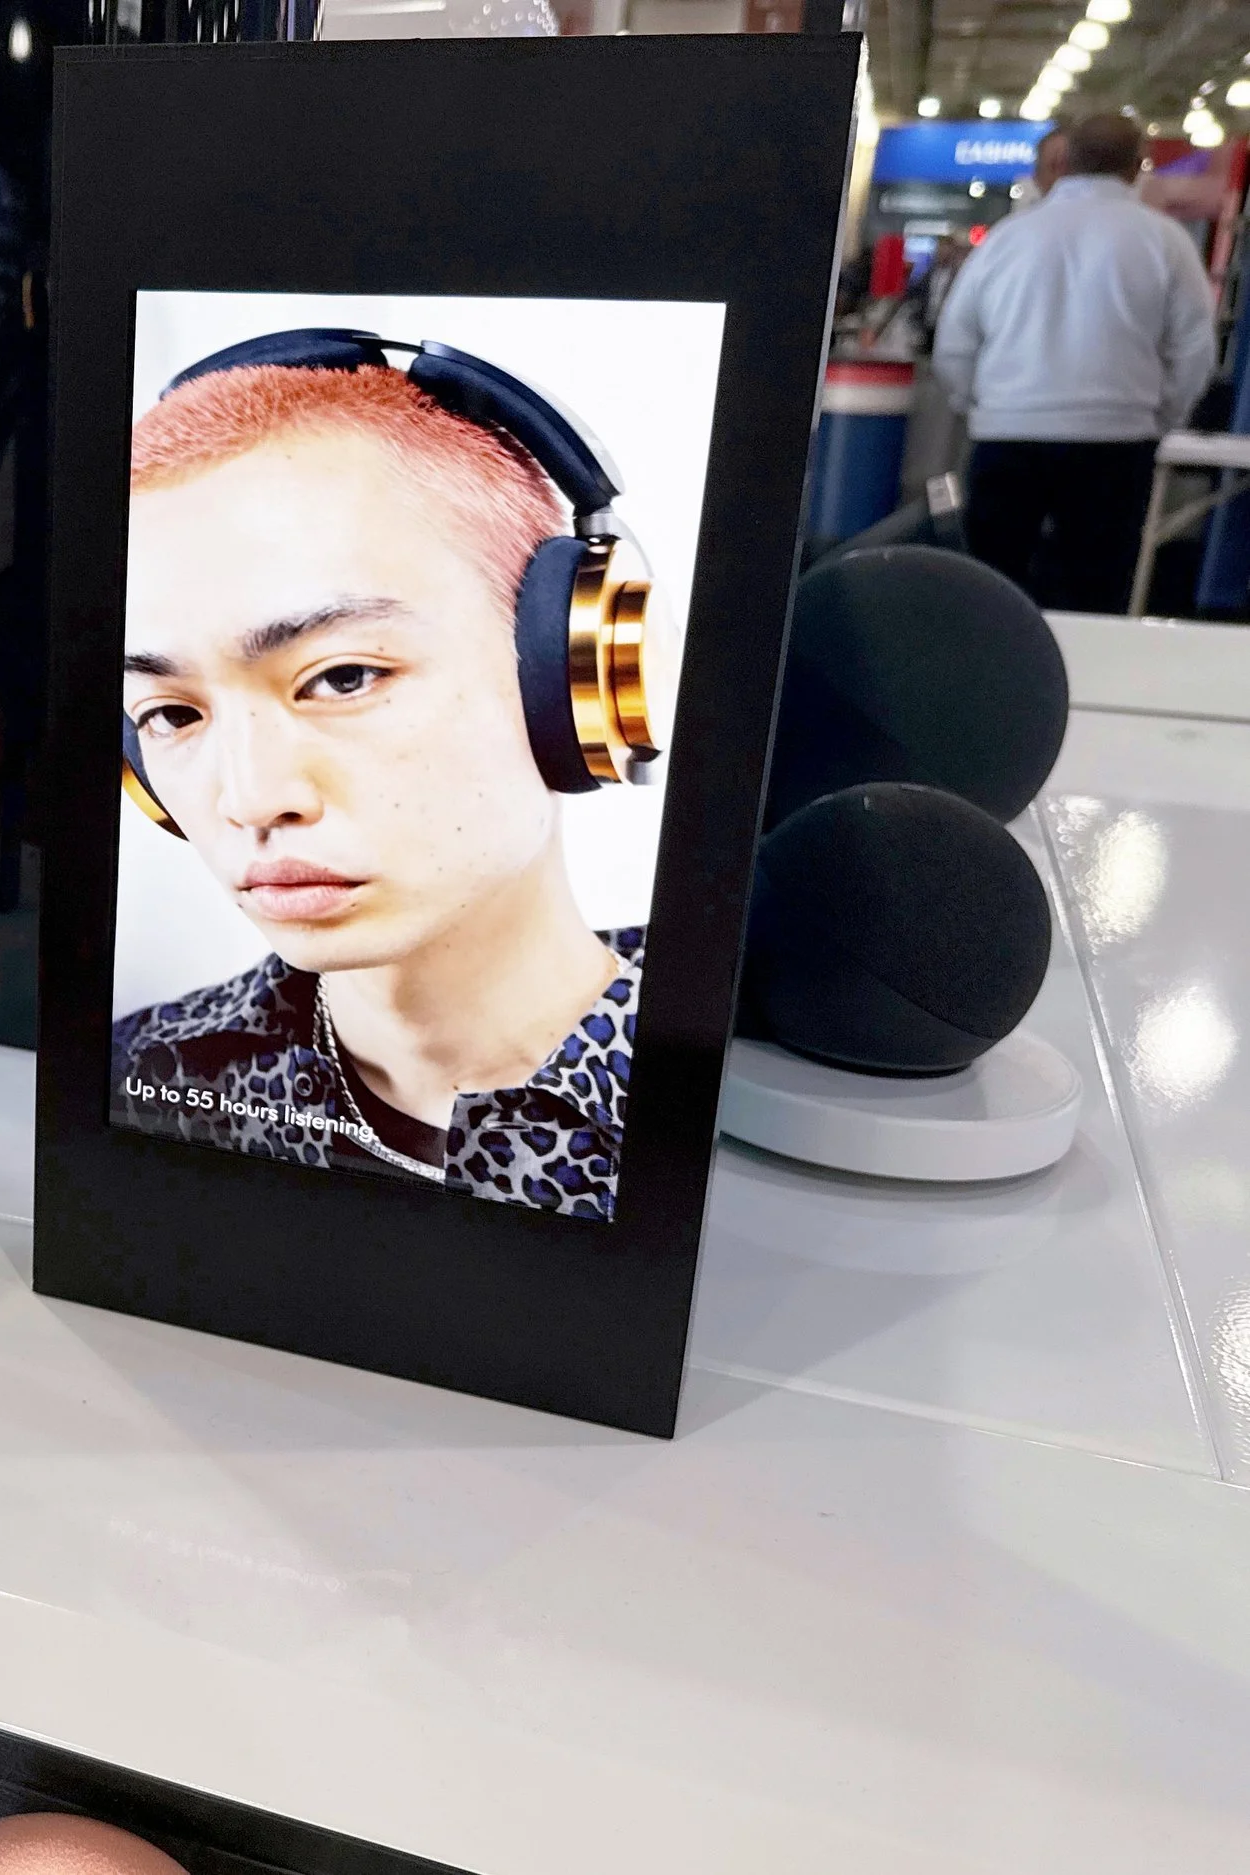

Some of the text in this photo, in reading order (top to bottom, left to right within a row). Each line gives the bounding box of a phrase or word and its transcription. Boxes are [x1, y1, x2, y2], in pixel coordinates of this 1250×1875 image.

[125, 1076, 374, 1143] Up to 55 hours listening
